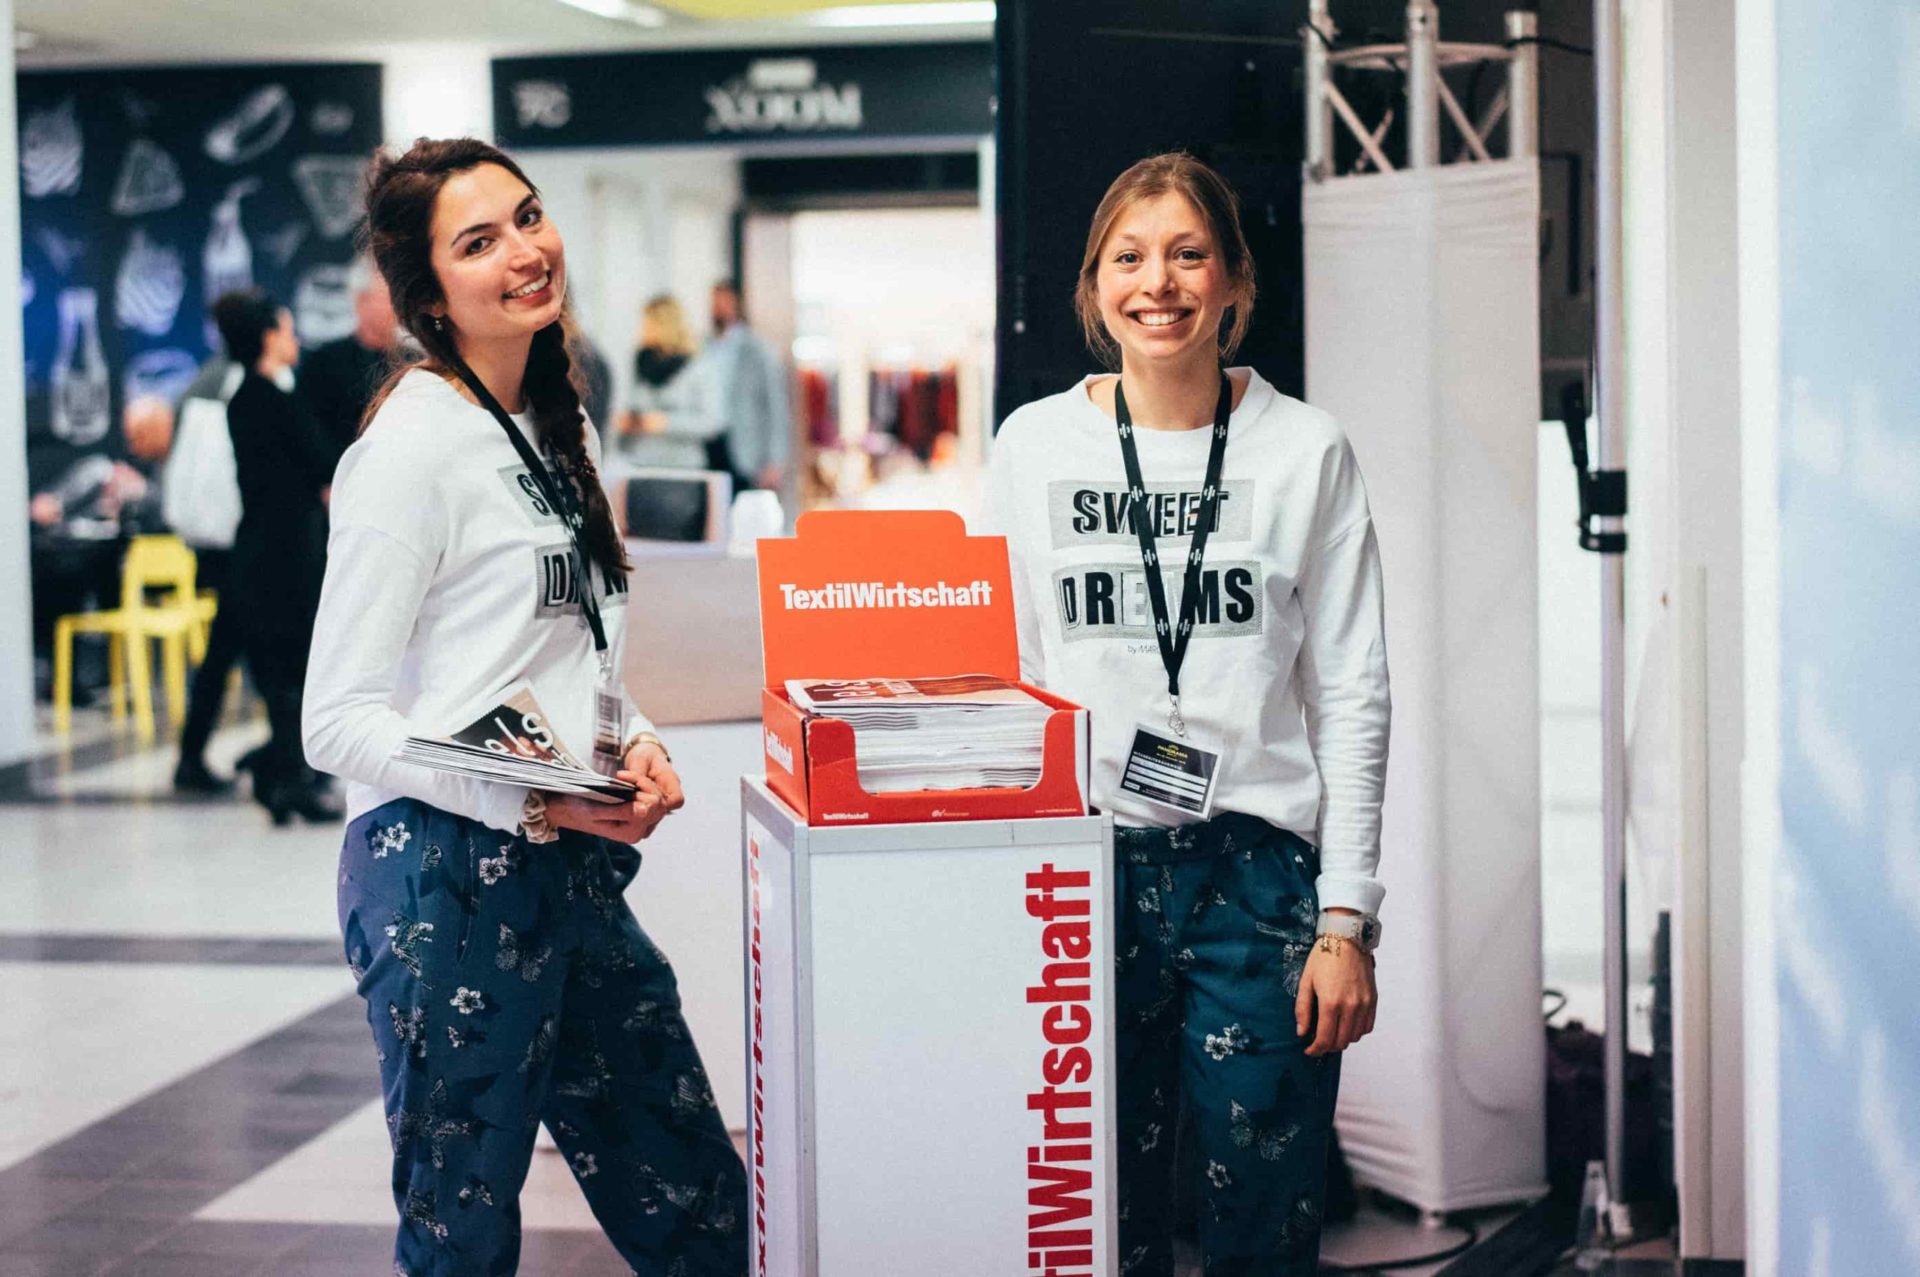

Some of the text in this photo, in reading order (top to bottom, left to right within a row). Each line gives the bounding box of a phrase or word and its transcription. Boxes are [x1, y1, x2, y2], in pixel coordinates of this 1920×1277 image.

[1073, 490, 1229, 537] SWEET
[780, 581, 993, 610] TextilWirtschaft
[750, 837, 767, 1277] xtilWirtschaft
